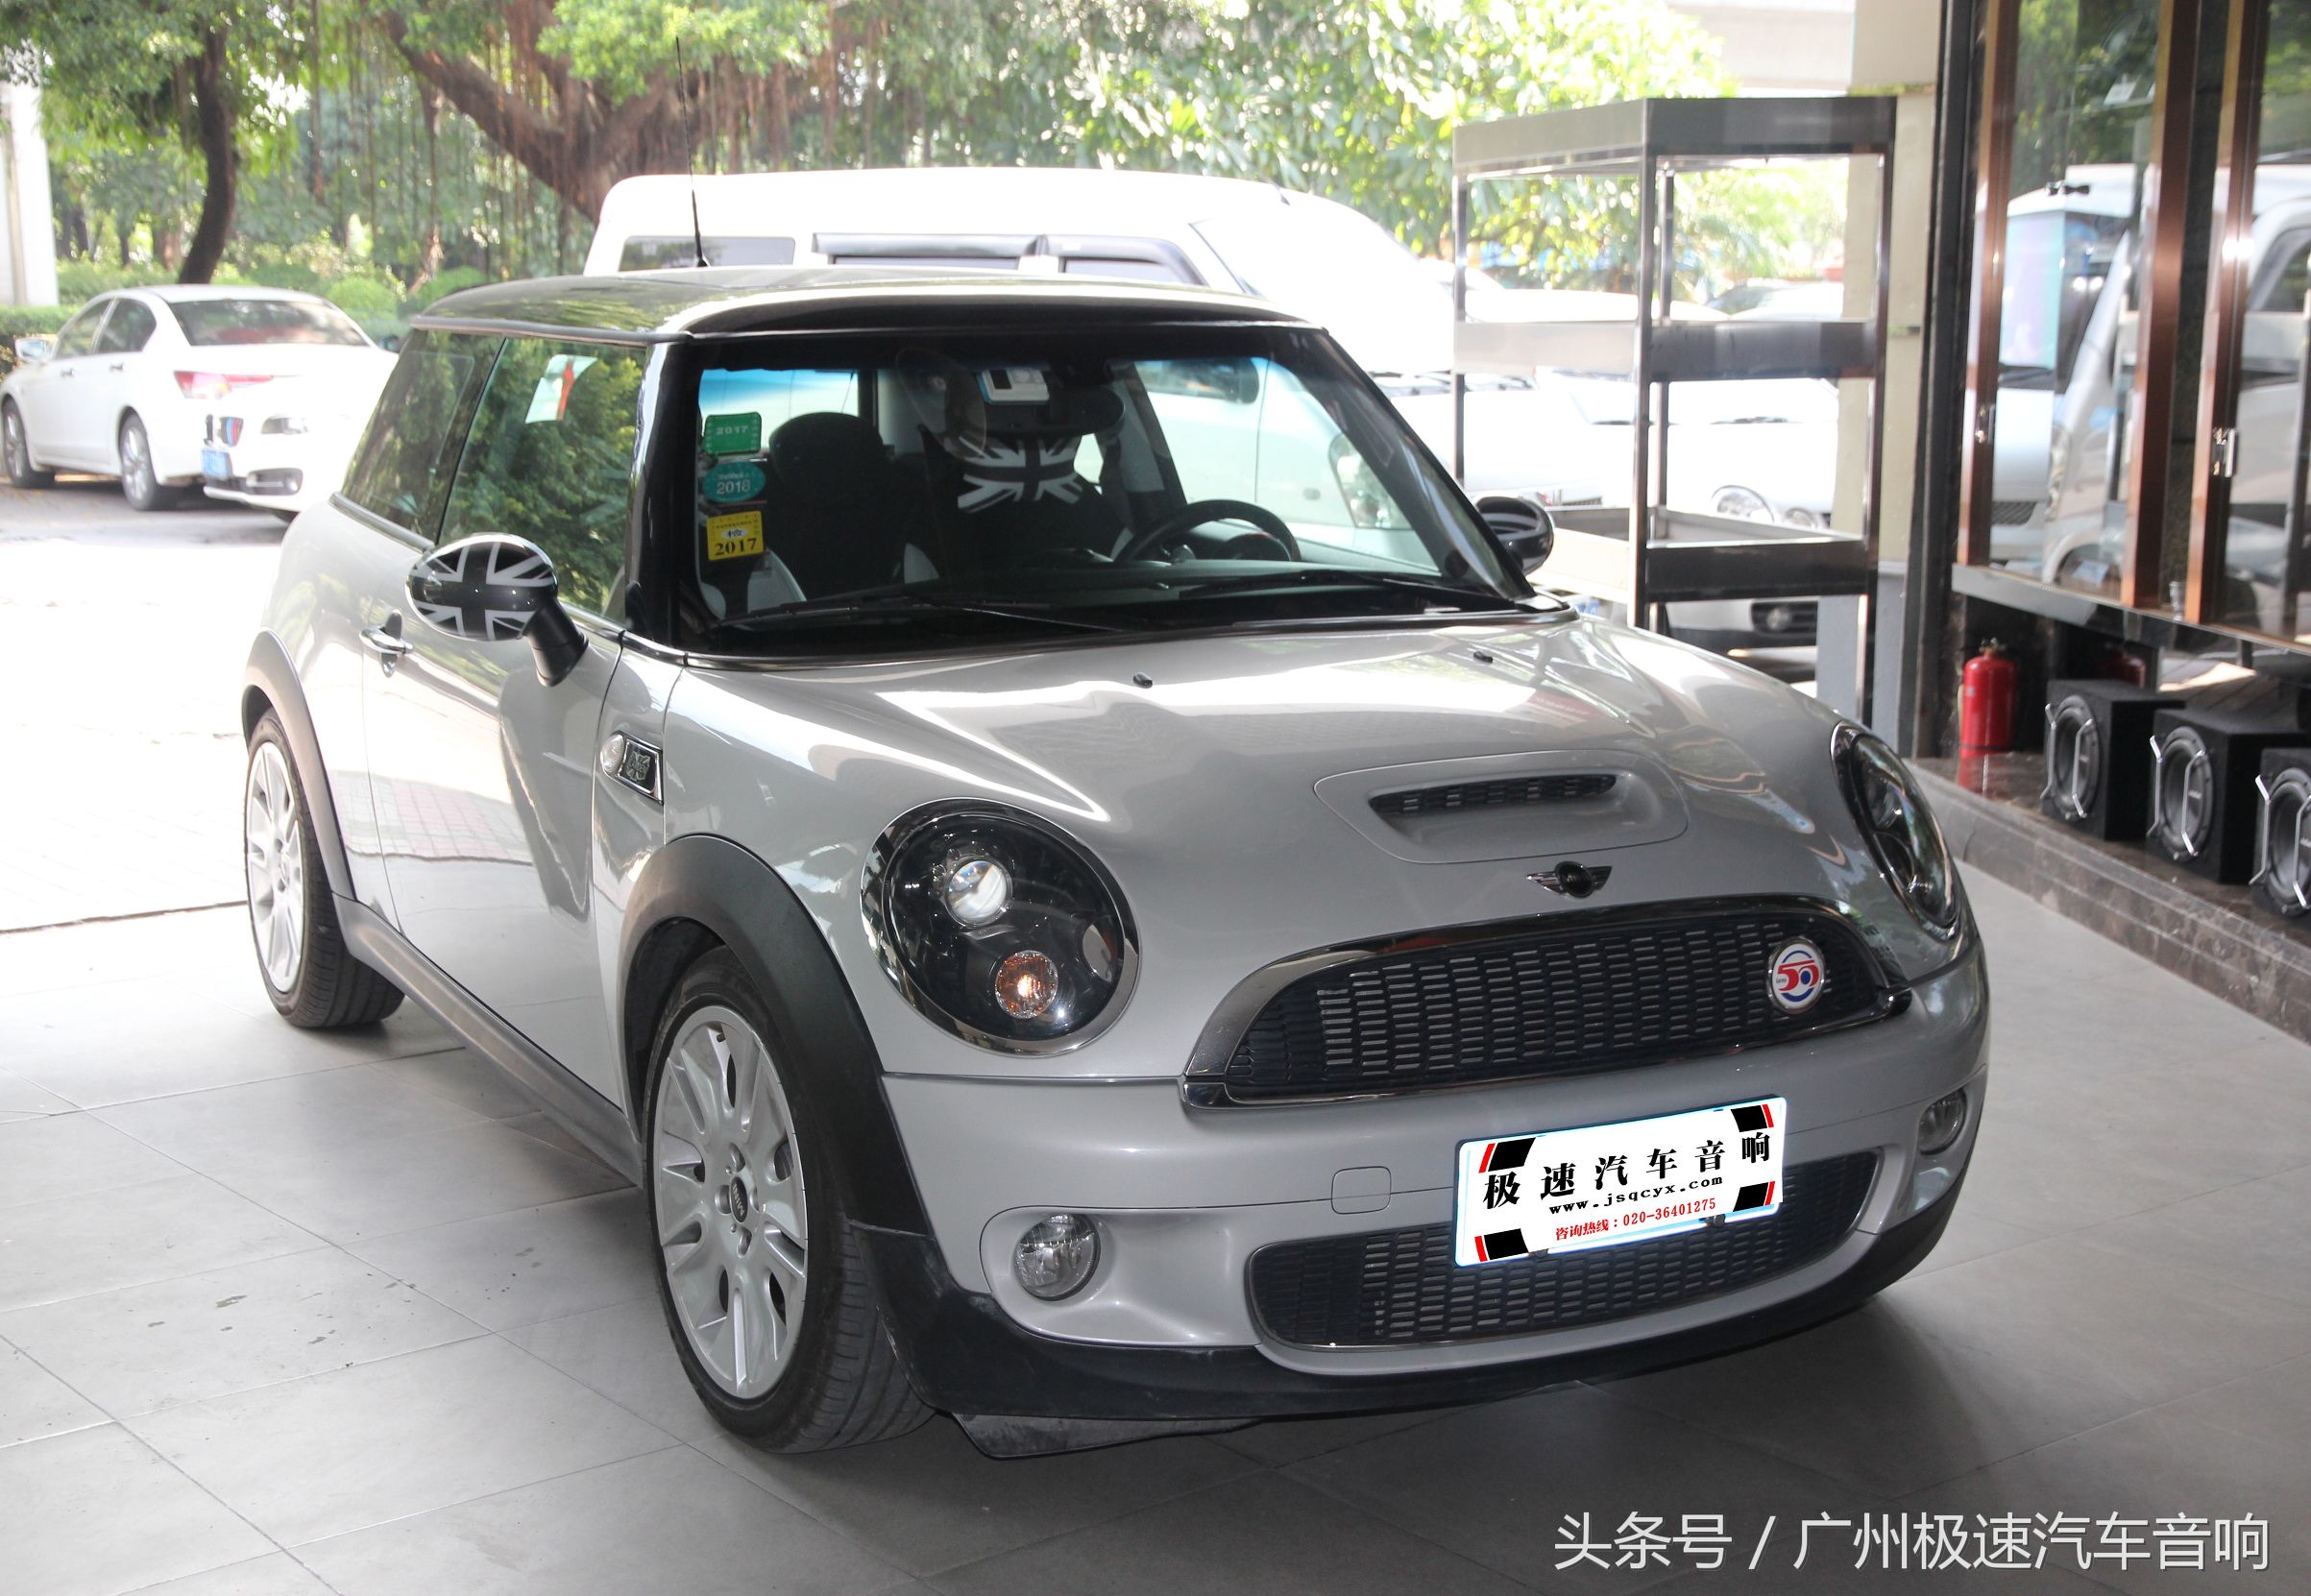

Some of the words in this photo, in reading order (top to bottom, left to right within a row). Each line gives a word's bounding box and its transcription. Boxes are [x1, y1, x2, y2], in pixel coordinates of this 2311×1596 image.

[716, 425, 748, 435] 2017
[717, 480, 750, 495] 2018
[715, 538, 757, 556] 2017
[1483, 1131, 1771, 1210] 极速汽车音响
[1549, 1174, 1723, 1215] www.jsqcyx.com
